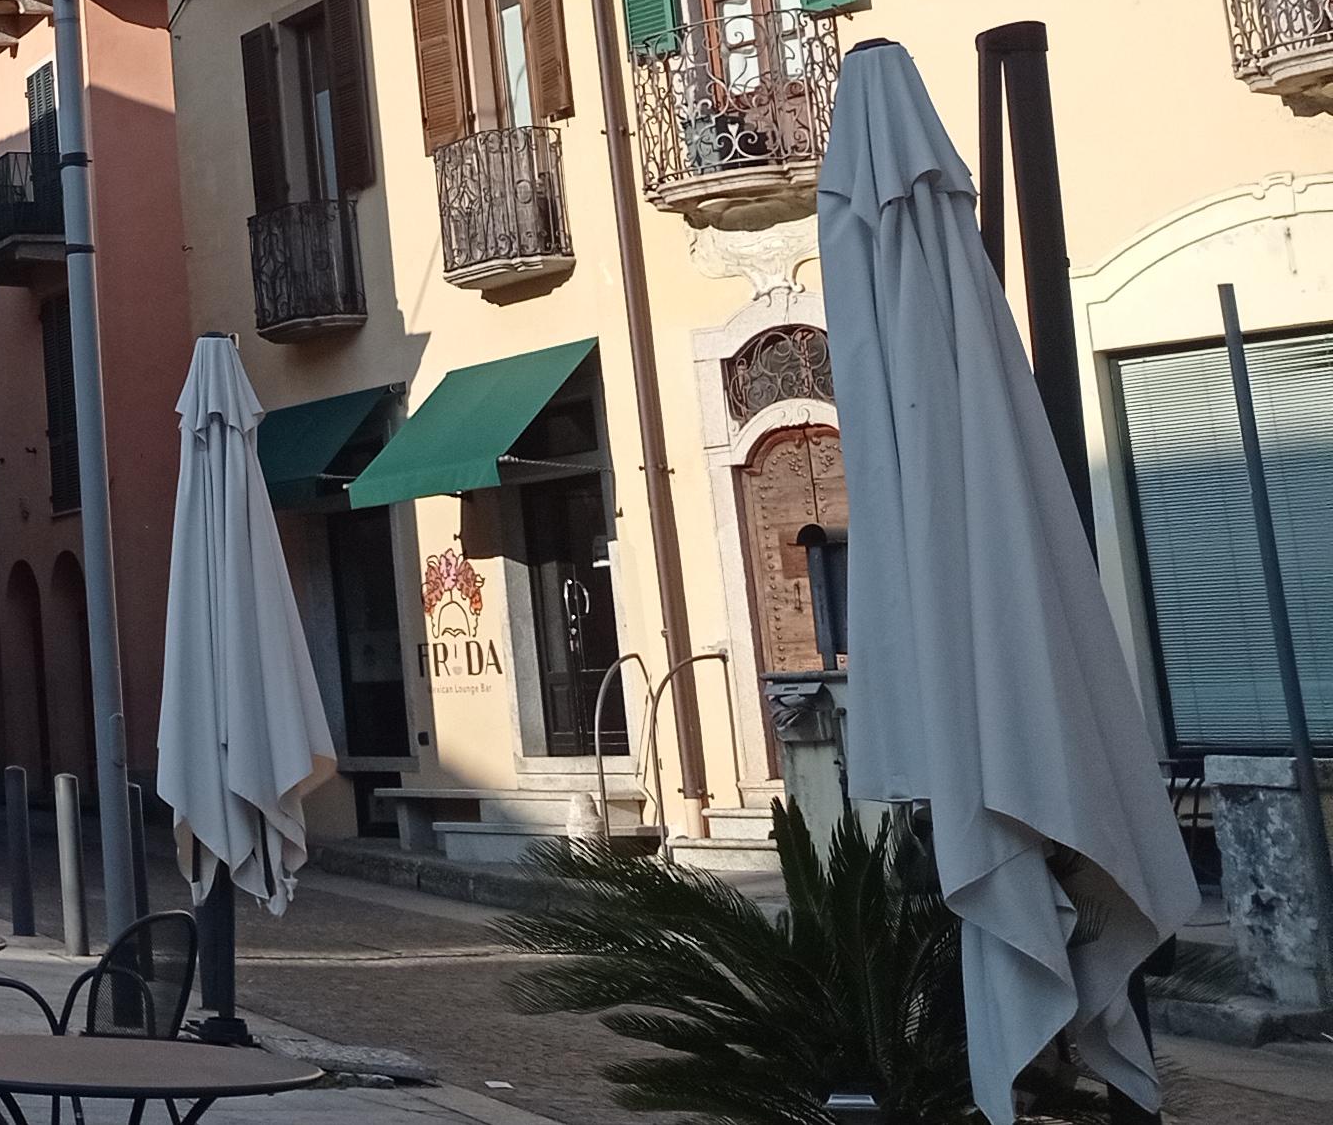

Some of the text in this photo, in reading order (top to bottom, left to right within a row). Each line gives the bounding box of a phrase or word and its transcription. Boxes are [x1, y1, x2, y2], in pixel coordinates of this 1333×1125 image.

[417, 639, 503, 677] FRIDA
[455, 684, 479, 695] Lounge
[481, 683, 492, 693] Bar
